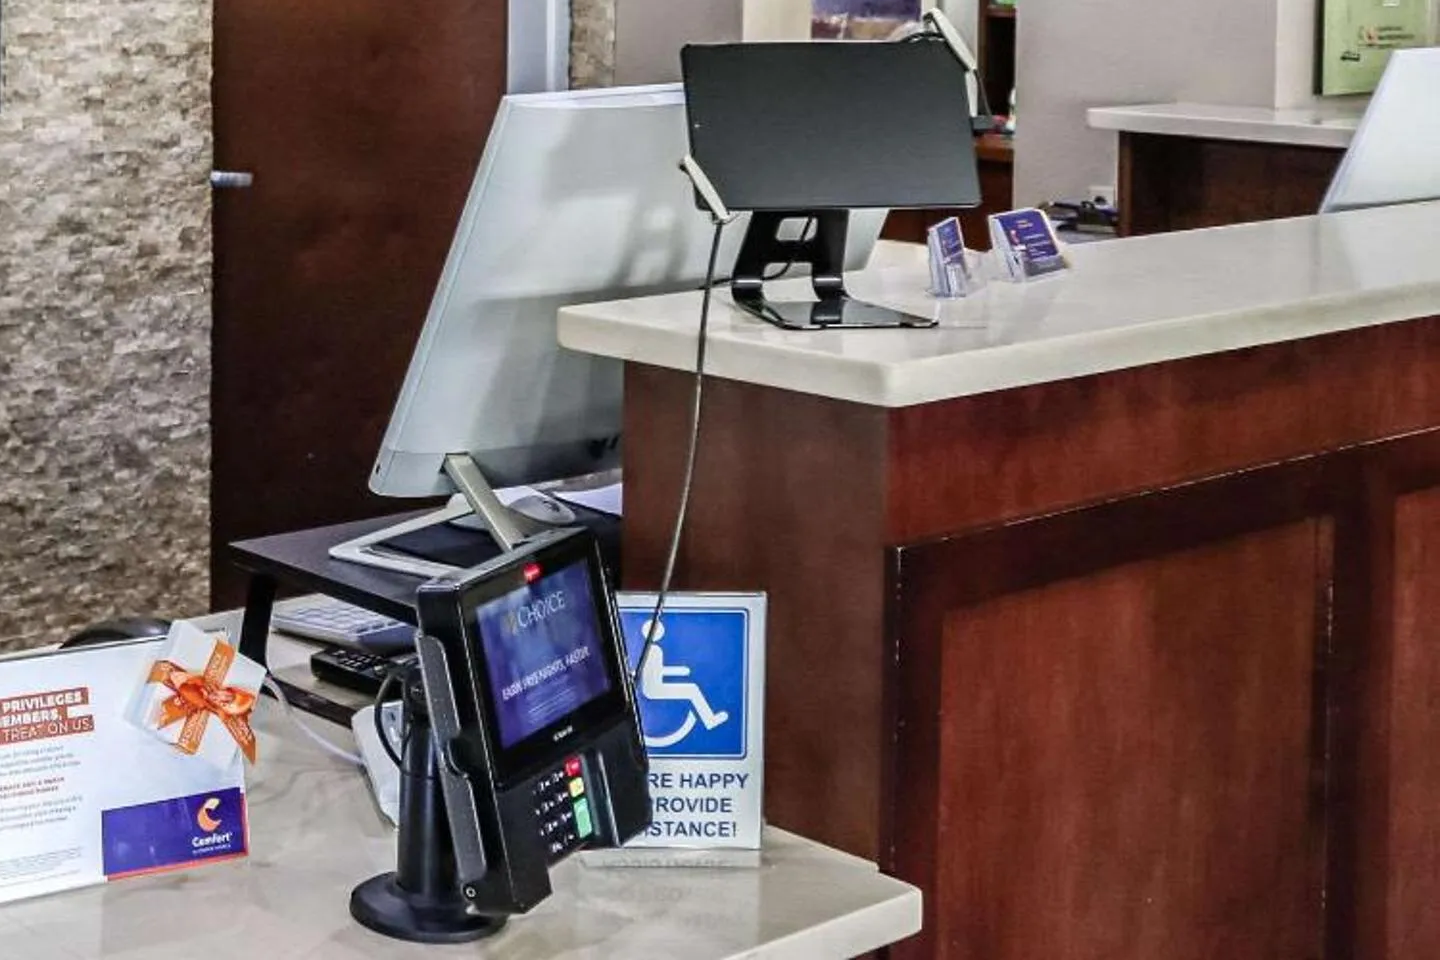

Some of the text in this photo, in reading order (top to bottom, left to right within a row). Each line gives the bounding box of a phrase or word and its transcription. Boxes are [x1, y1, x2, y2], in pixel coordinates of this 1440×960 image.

[517, 591, 567, 628] CHOICE
[2, 691, 83, 713] PRIVILEGES
[3, 725, 42, 743] TREAT
[48, 720, 68, 735] ON
[649, 772, 750, 790] RE HAPPY
[652, 797, 733, 814] ROVIDE
[644, 820, 736, 838] ISTANCE!
[191, 832, 231, 847] Comfort
